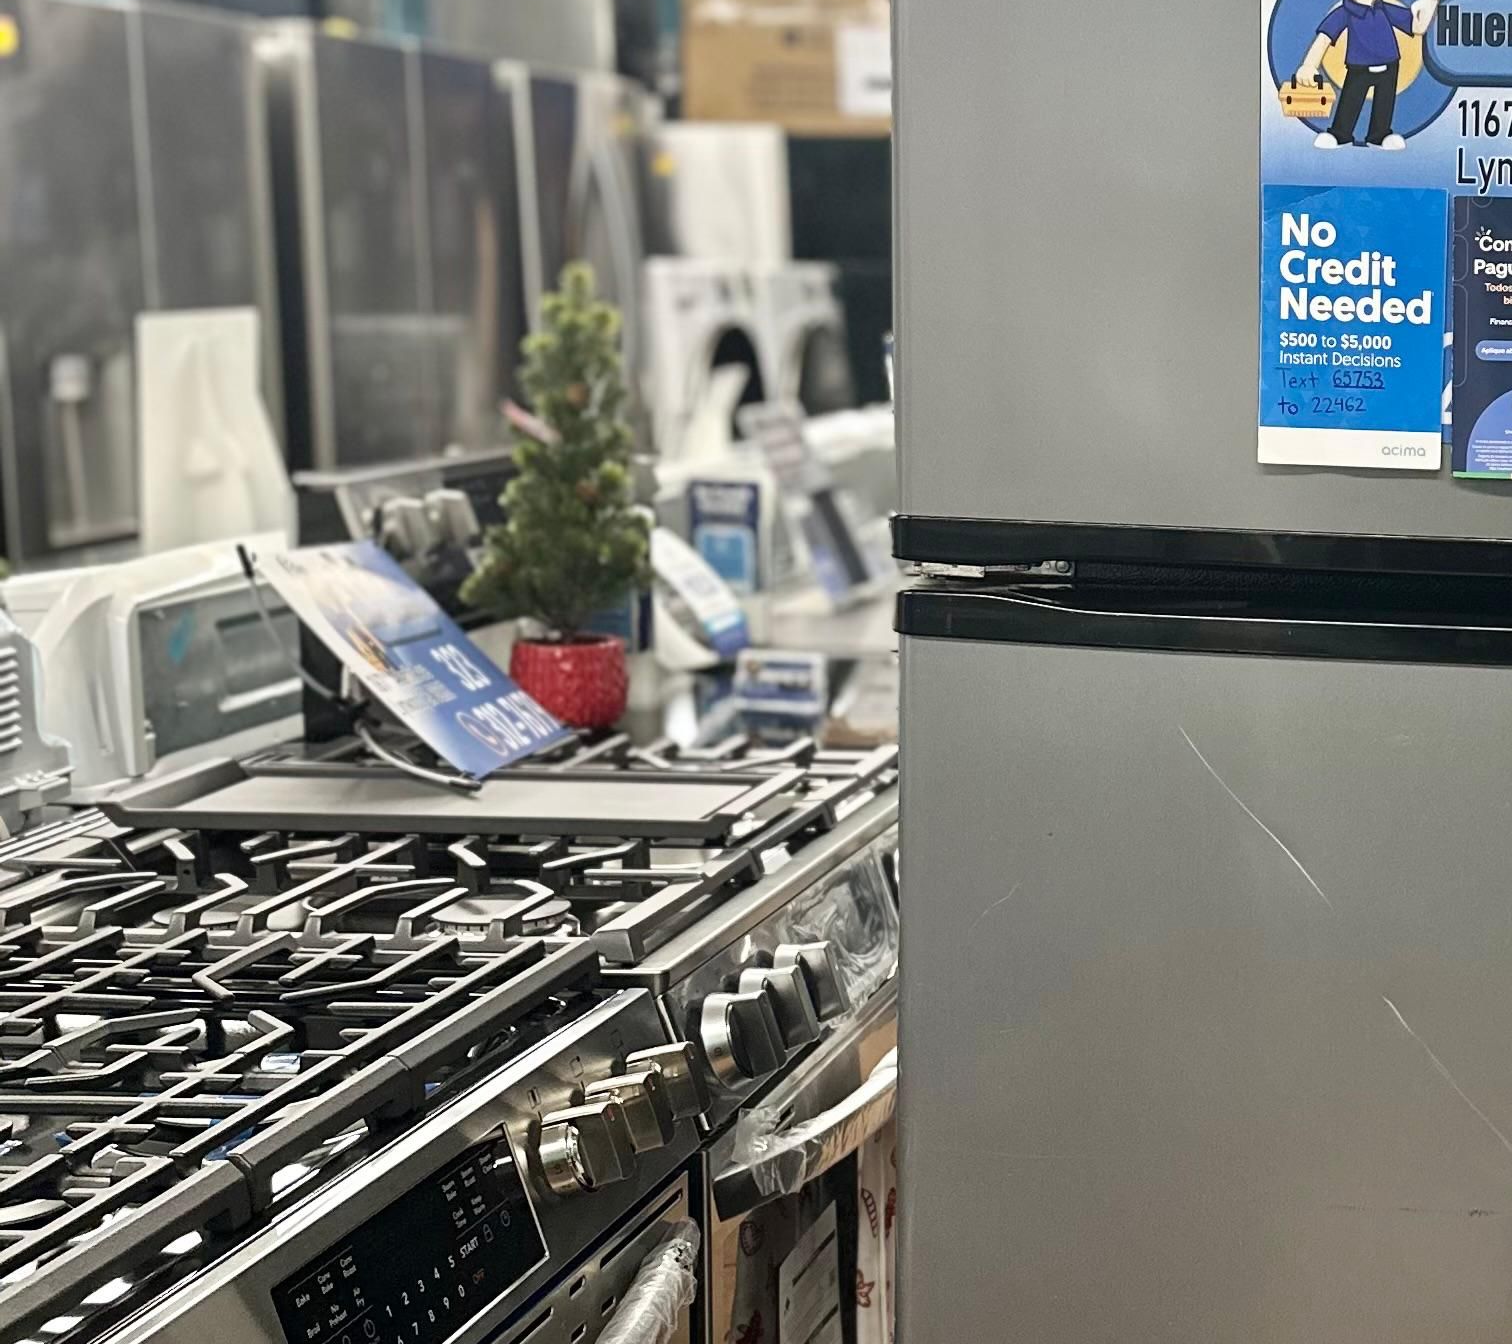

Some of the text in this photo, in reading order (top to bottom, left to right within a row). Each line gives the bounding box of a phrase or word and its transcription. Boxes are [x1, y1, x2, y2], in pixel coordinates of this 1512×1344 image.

[1281, 213, 1337, 247] No
[1280, 250, 1396, 286] Credit
[1280, 287, 1432, 325] Needed
[1280, 332, 1392, 350] $500 to $5,000
[1481, 347, 1506, 356] Aplique
[1280, 350, 1402, 368] Instant Decisions
[1275, 367, 1385, 390] Text 65753
[1278, 396, 1367, 415] to 22462
[1381, 445, 1426, 457] acima
[385, 1235, 480, 1318] 1 2 3 4 5 START
[411, 1321, 420, 1336] 7
[427, 1308, 436, 1323] 8
[442, 1296, 451, 1310] 9
[457, 1284, 466, 1298] 0
